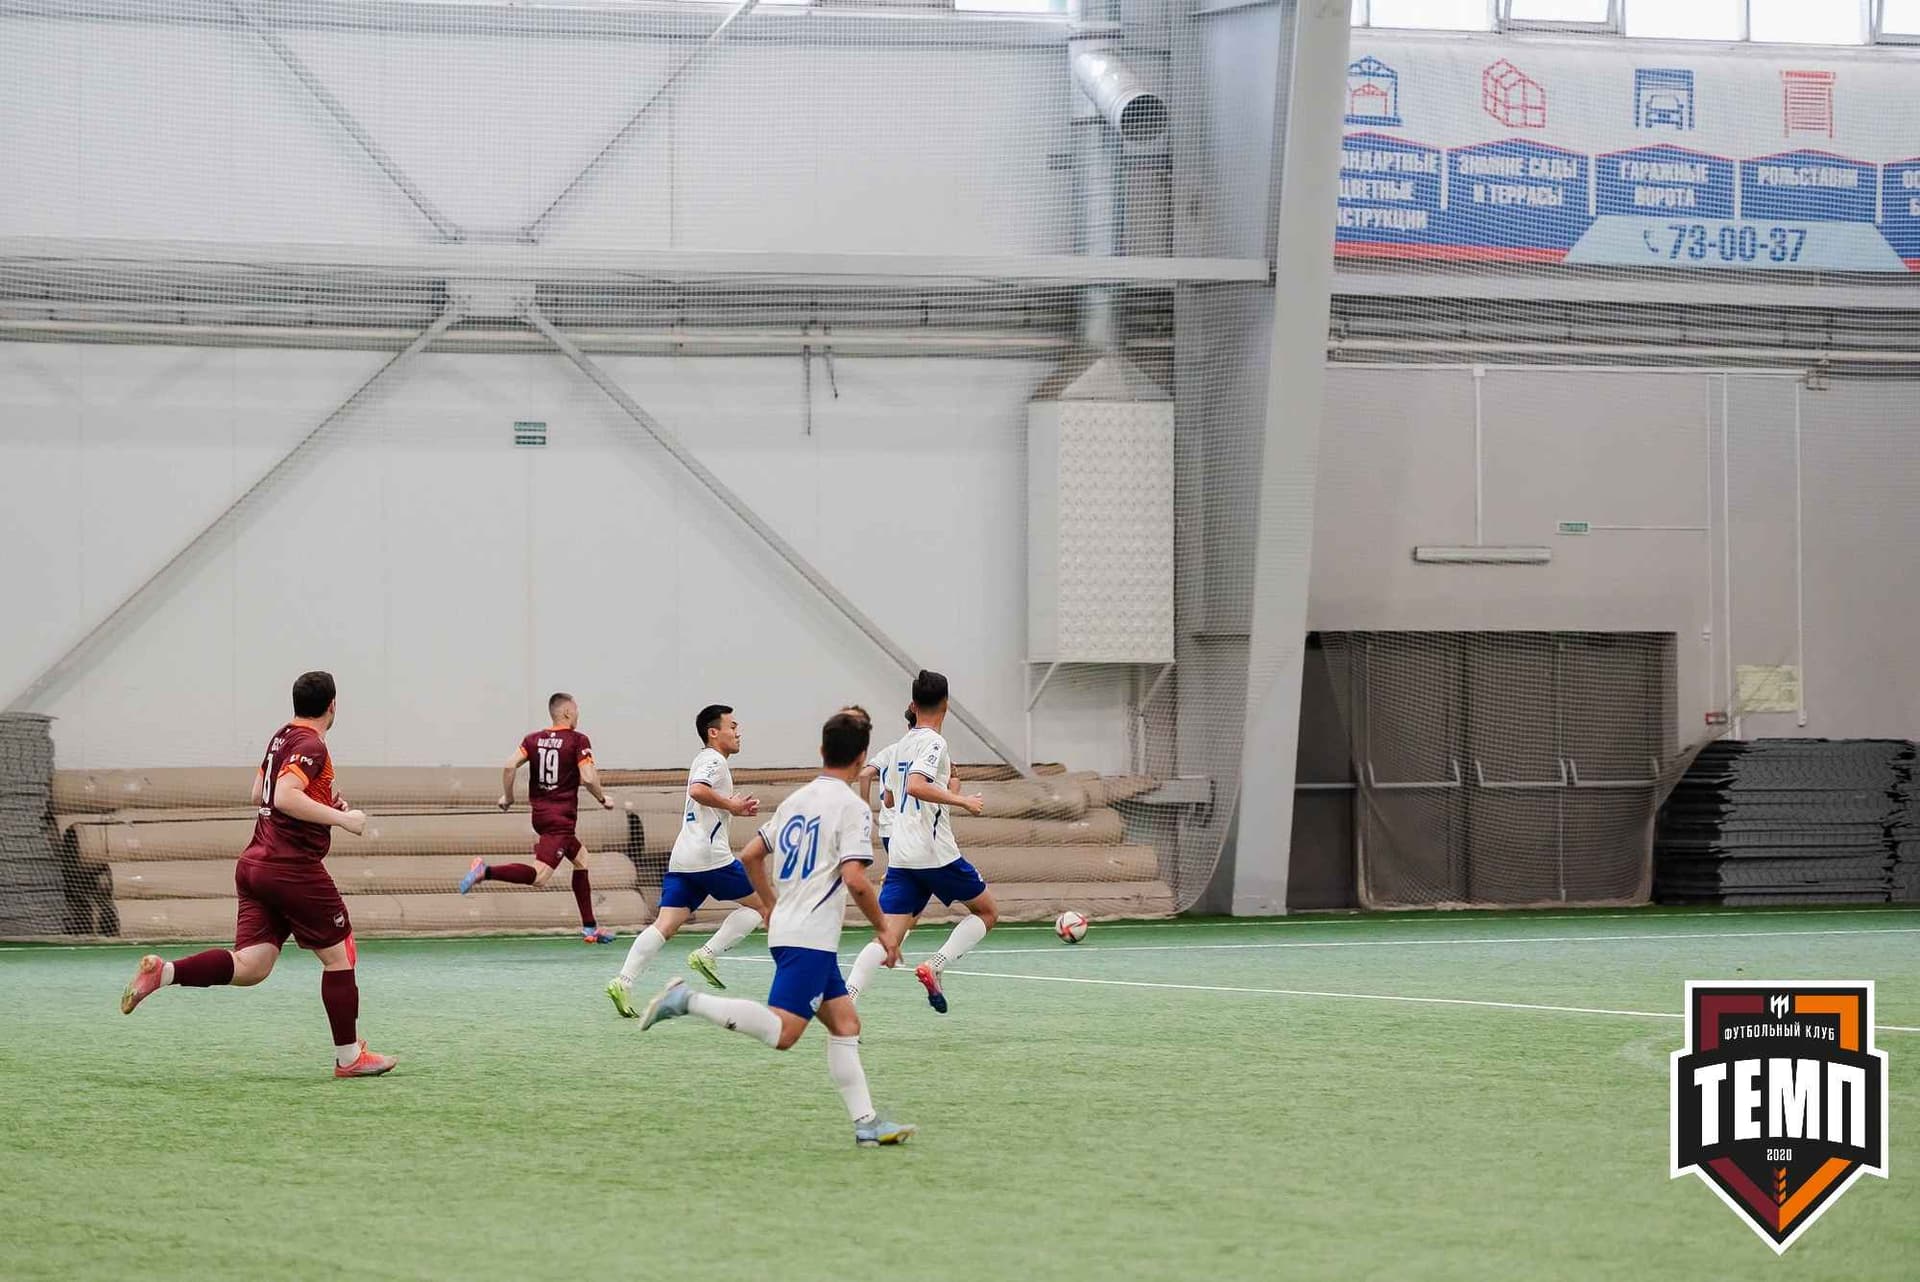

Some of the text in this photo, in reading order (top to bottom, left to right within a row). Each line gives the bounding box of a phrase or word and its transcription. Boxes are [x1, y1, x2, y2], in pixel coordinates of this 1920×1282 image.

[1459, 155, 1578, 180] ЗИМНИЕ САДЫ
[1621, 160, 1709, 184] ГАРАЖНЫЕ
[1758, 166, 1858, 188] РОЛЬСТАВНИ
[1490, 185, 1563, 207] ТЕРРАСЫ
[1635, 186, 1696, 208] ВОРОТА
[1667, 224, 1807, 262] 73-00-37
[537, 747, 559, 785] 19
[779, 813, 821, 880] 91
